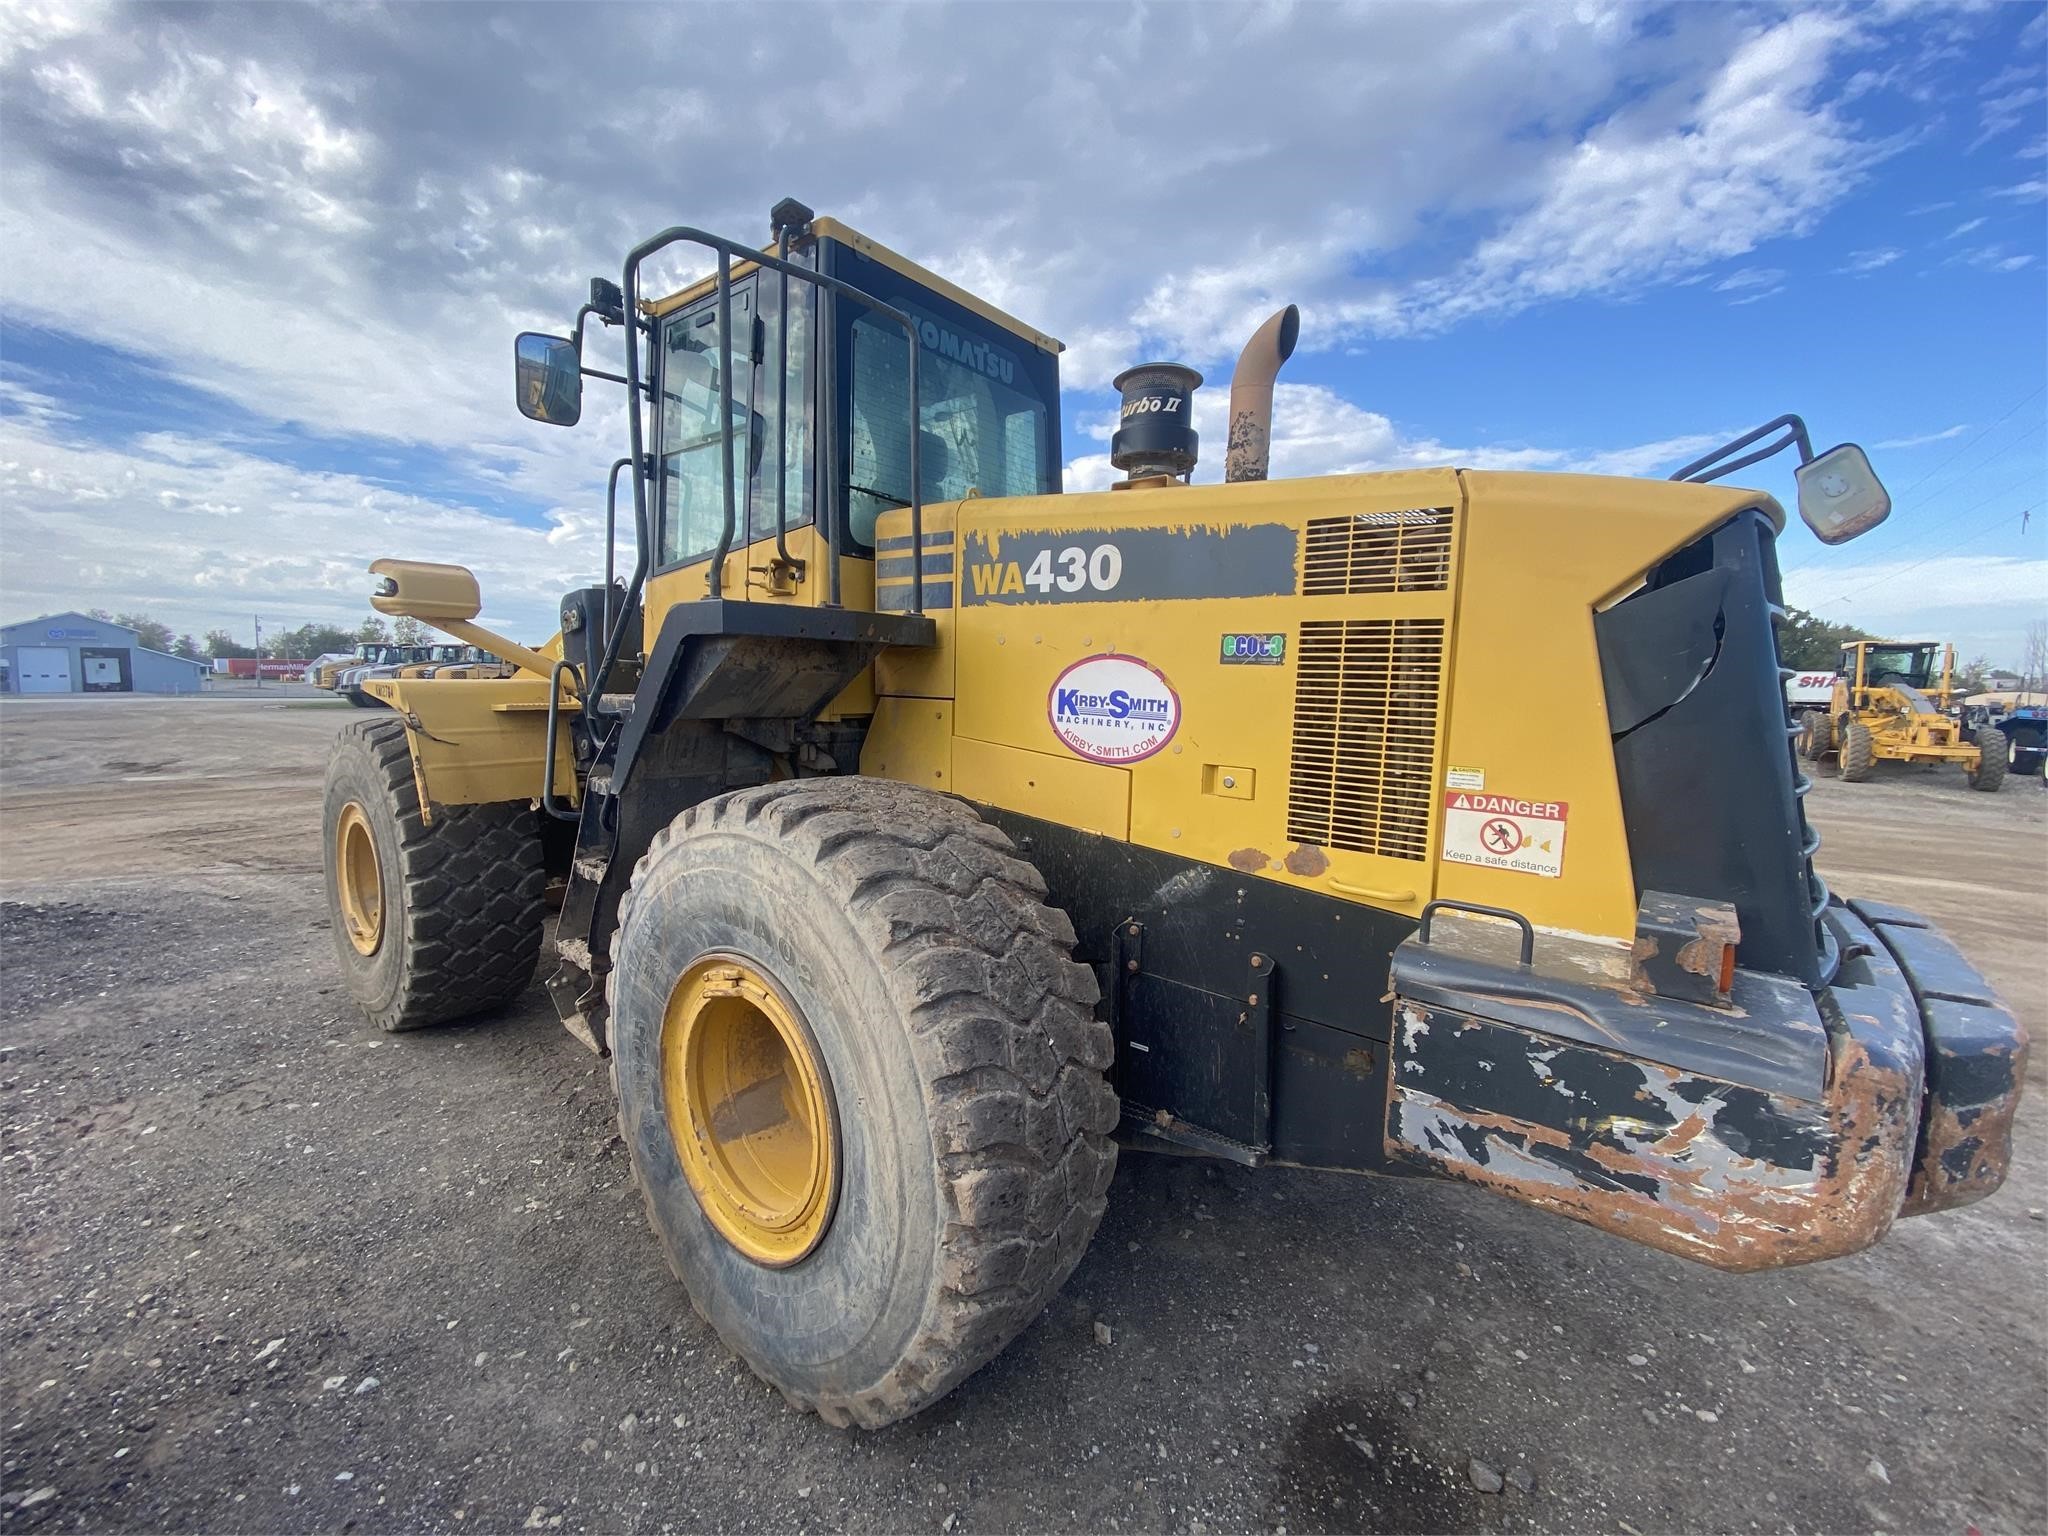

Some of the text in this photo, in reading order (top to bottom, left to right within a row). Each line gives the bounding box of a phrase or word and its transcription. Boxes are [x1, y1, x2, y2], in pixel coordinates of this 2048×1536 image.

[1063, 727, 1159, 757] KIRBY-SMITH.COM
[1473, 796, 1560, 818] DANGER
[1445, 849, 1472, 863] Keep
[1485, 857, 1508, 867] safe
[1510, 857, 1558, 874] distance
